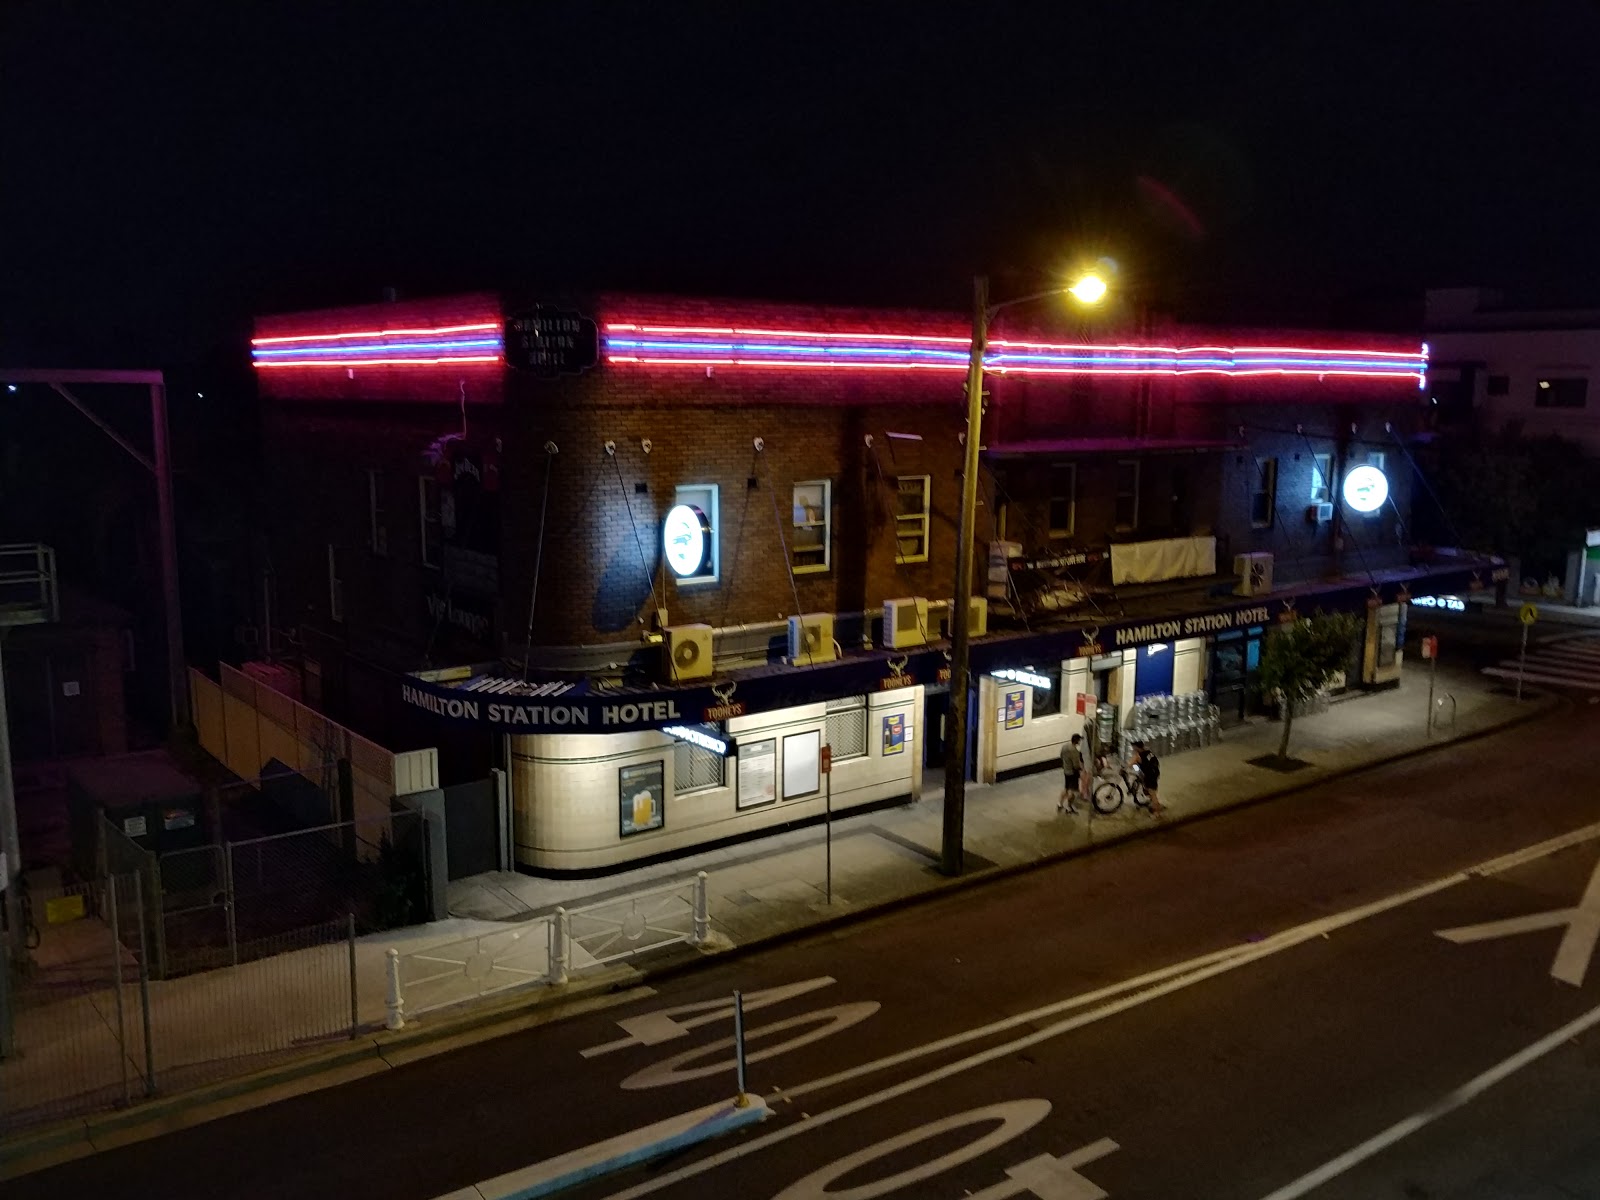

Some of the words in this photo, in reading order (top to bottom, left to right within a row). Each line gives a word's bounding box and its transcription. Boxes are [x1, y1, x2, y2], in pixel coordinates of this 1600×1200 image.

[1115, 620, 1182, 646] HAMILTON
[1184, 613, 1233, 634] STATION
[1235, 606, 1270, 624] HOTEL
[402, 683, 479, 720] HAMILTON
[487, 703, 589, 725] STATION
[602, 699, 682, 725] HOTEL
[707, 702, 742, 720] TOOHEYS
